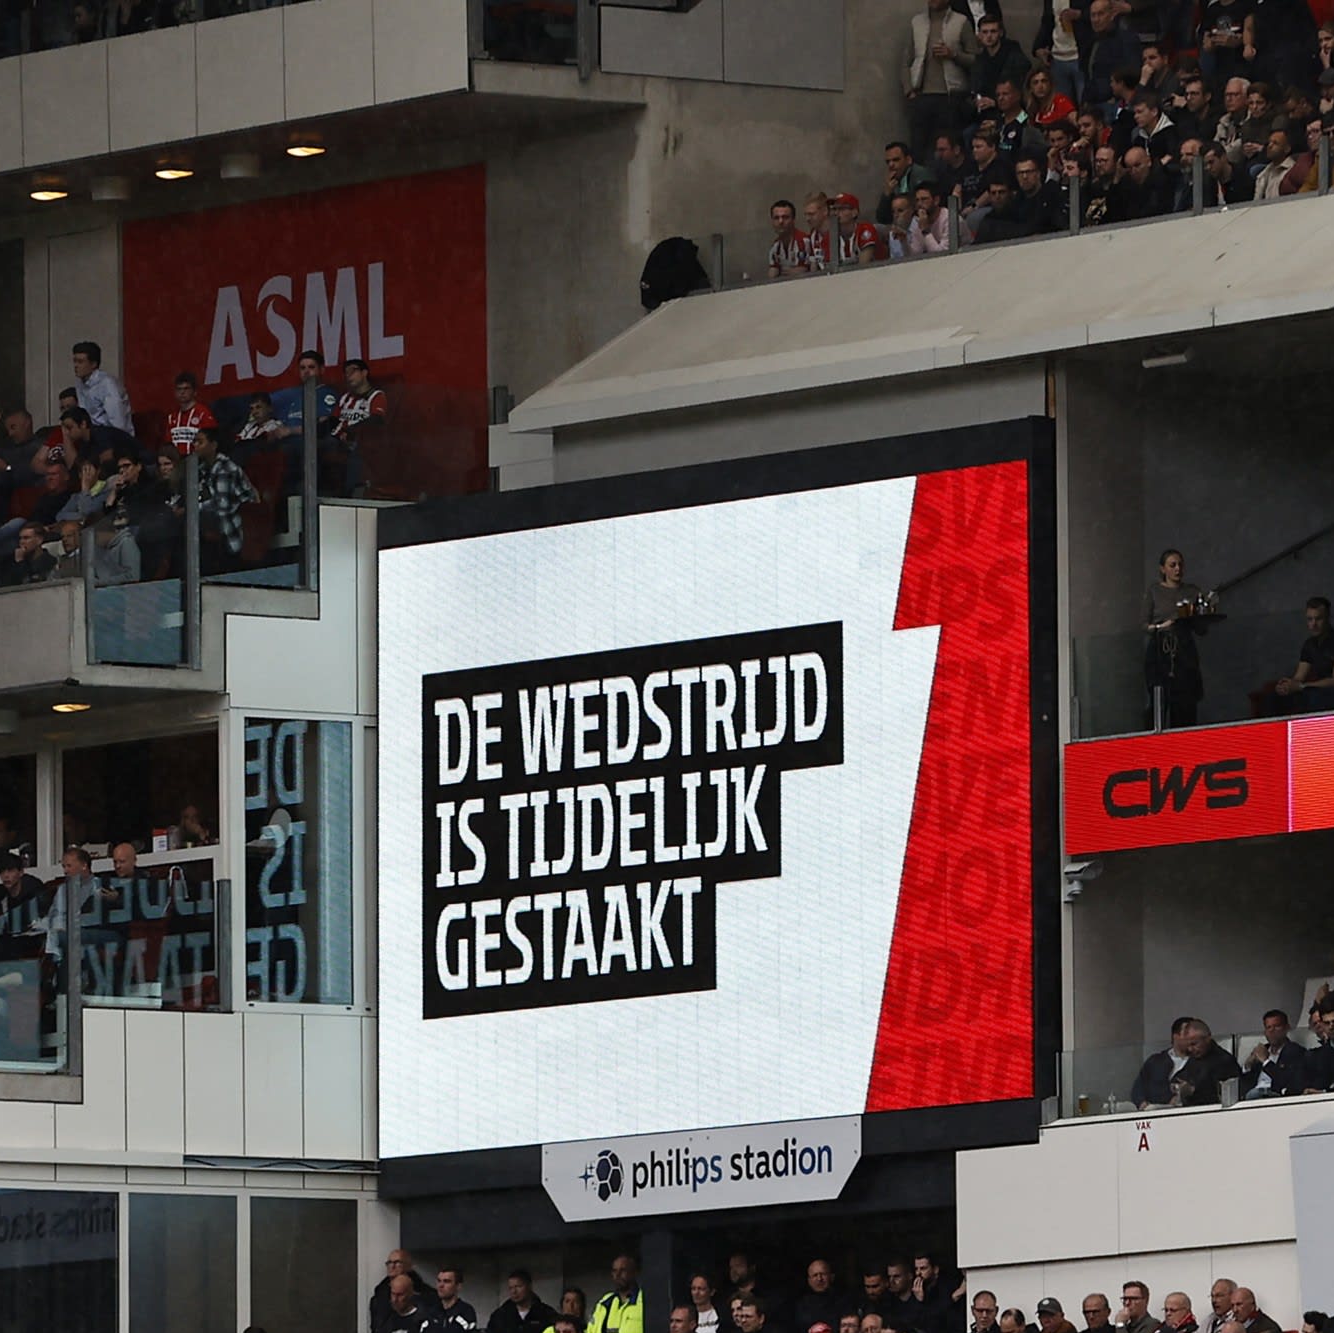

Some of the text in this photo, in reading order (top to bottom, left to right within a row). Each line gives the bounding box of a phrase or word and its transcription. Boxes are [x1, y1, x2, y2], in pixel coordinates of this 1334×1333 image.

[204, 262, 404, 385] ASML
[434, 652, 828, 786] DE WEDSTRIJD
[436, 764, 768, 888] IS TIJDELIJK
[1102, 758, 1249, 819] CWS
[435, 876, 702, 991] GESTAAKT
[631, 1138, 833, 1198] philips stadion
[1135, 1121, 1152, 1131] VAK
[1138, 1132, 1150, 1152] A
